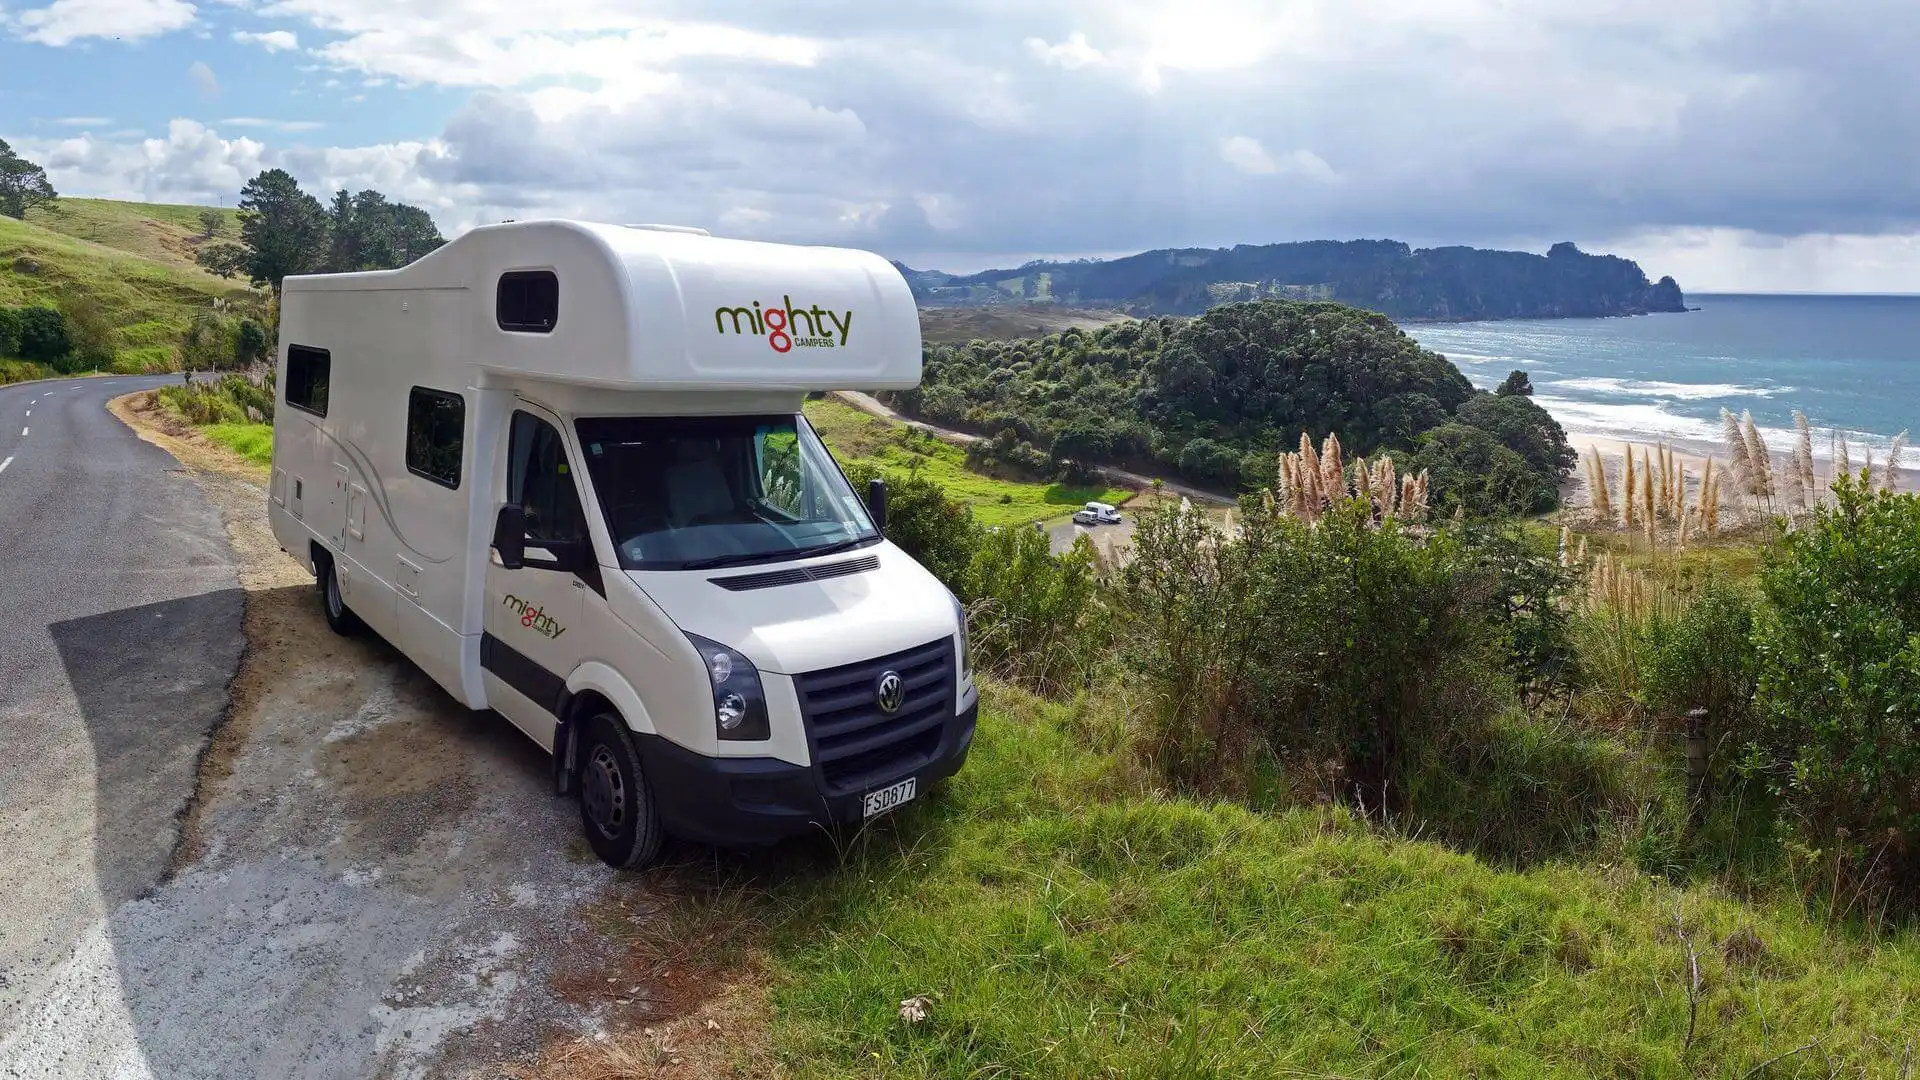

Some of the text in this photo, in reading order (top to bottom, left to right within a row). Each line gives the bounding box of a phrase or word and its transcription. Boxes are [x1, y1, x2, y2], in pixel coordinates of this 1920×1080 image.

[715, 294, 852, 353] mighty
[794, 337, 835, 348] CAMPERS
[503, 594, 566, 639] mighty
[865, 780, 915, 815] FSD877
